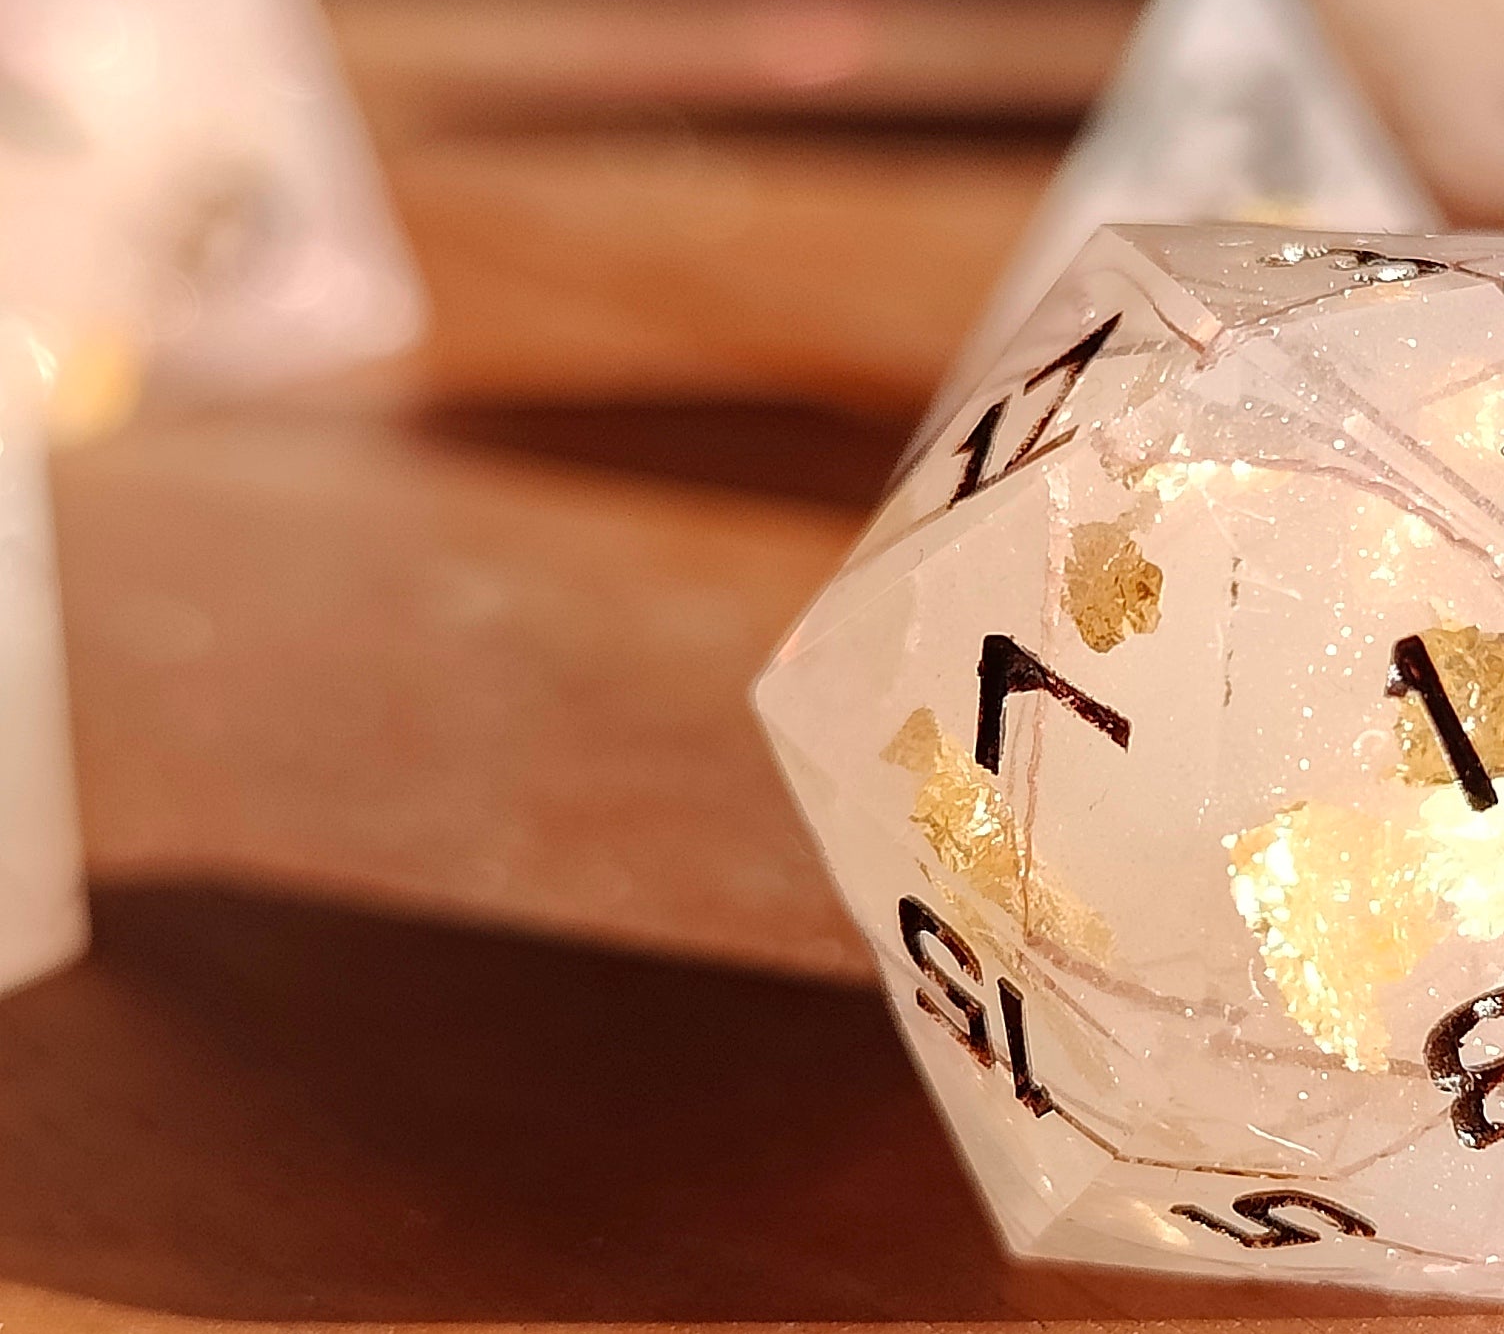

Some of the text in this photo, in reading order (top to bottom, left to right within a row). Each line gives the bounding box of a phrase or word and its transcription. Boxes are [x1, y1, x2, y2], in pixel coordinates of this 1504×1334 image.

[975, 634, 1131, 776] 7
[1384, 634, 1499, 811] 1
[898, 895, 1054, 1118] 15
